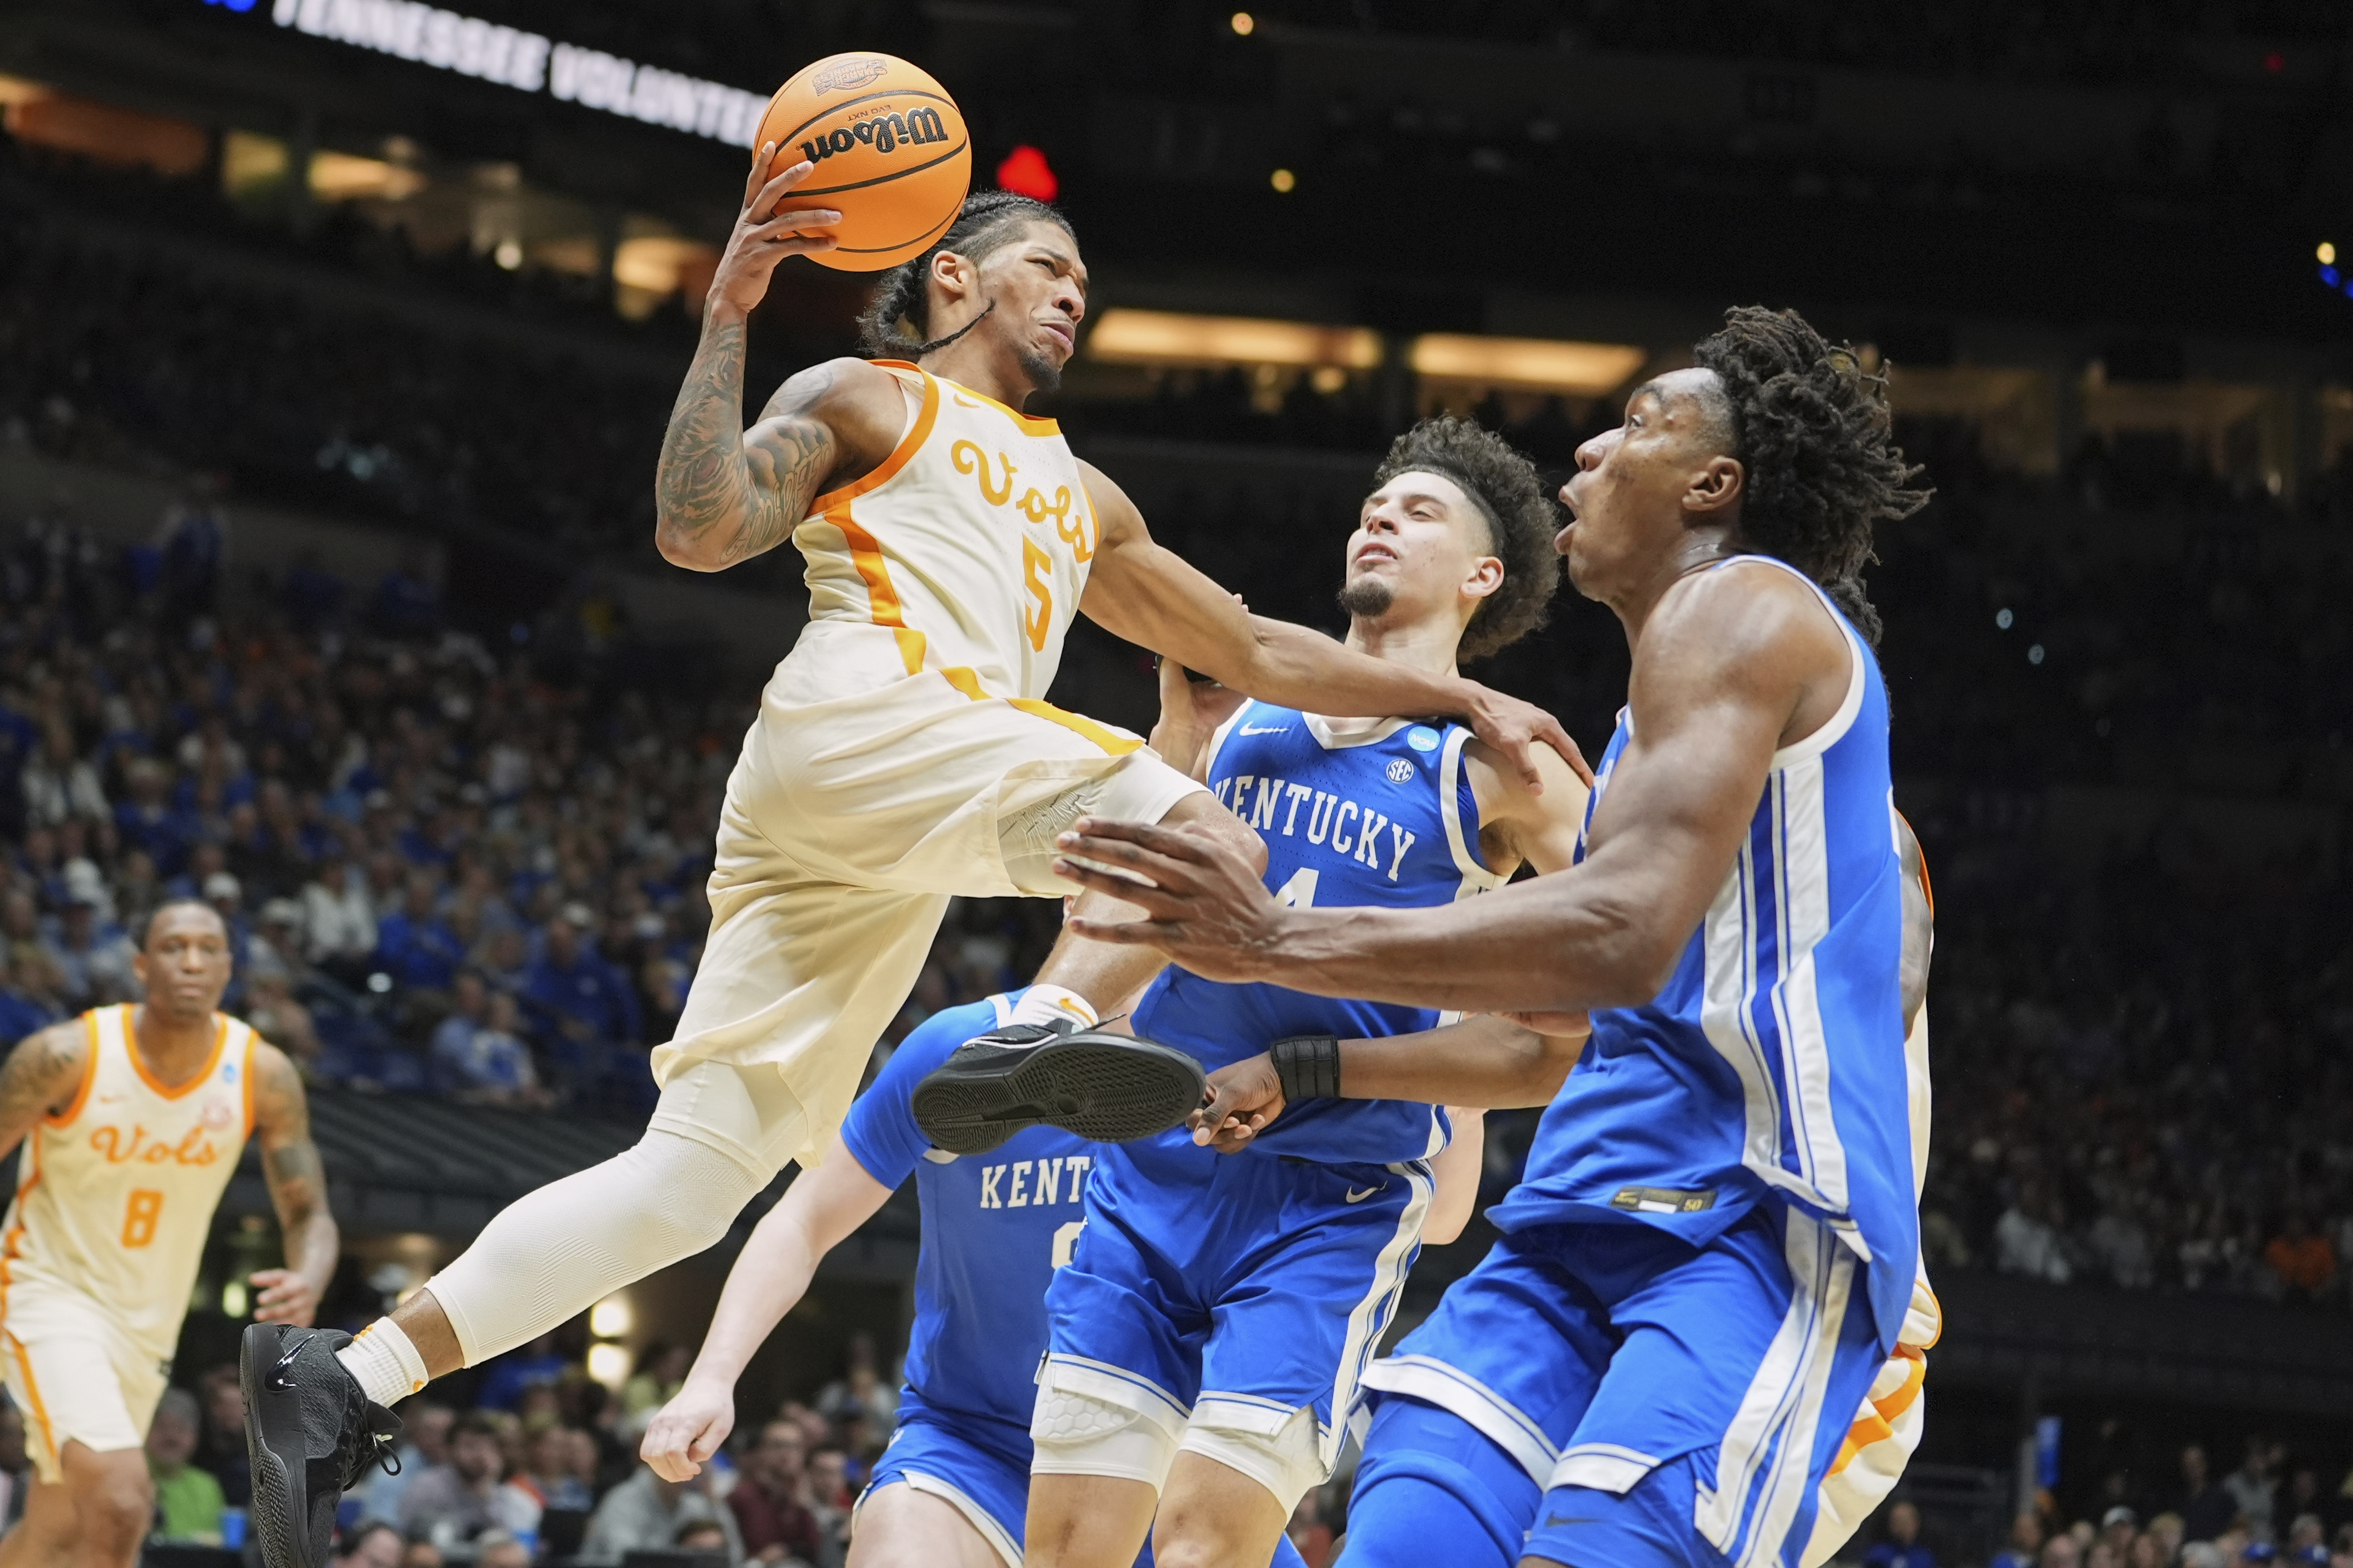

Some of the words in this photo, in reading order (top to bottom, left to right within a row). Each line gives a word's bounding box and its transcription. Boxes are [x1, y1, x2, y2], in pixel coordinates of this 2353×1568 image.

[848, 111, 869, 121] NXT
[871, 105, 892, 114] EVO
[801, 106, 949, 164] Wilson
[951, 439, 1093, 564] Vols
[1022, 532, 1052, 653] 5
[1410, 733, 1437, 749] NCAA
[1388, 760, 1411, 782] SEC
[89, 1124, 217, 1168] Vols
[980, 1156, 1097, 1209] KENT
[120, 1187, 163, 1249] 8
